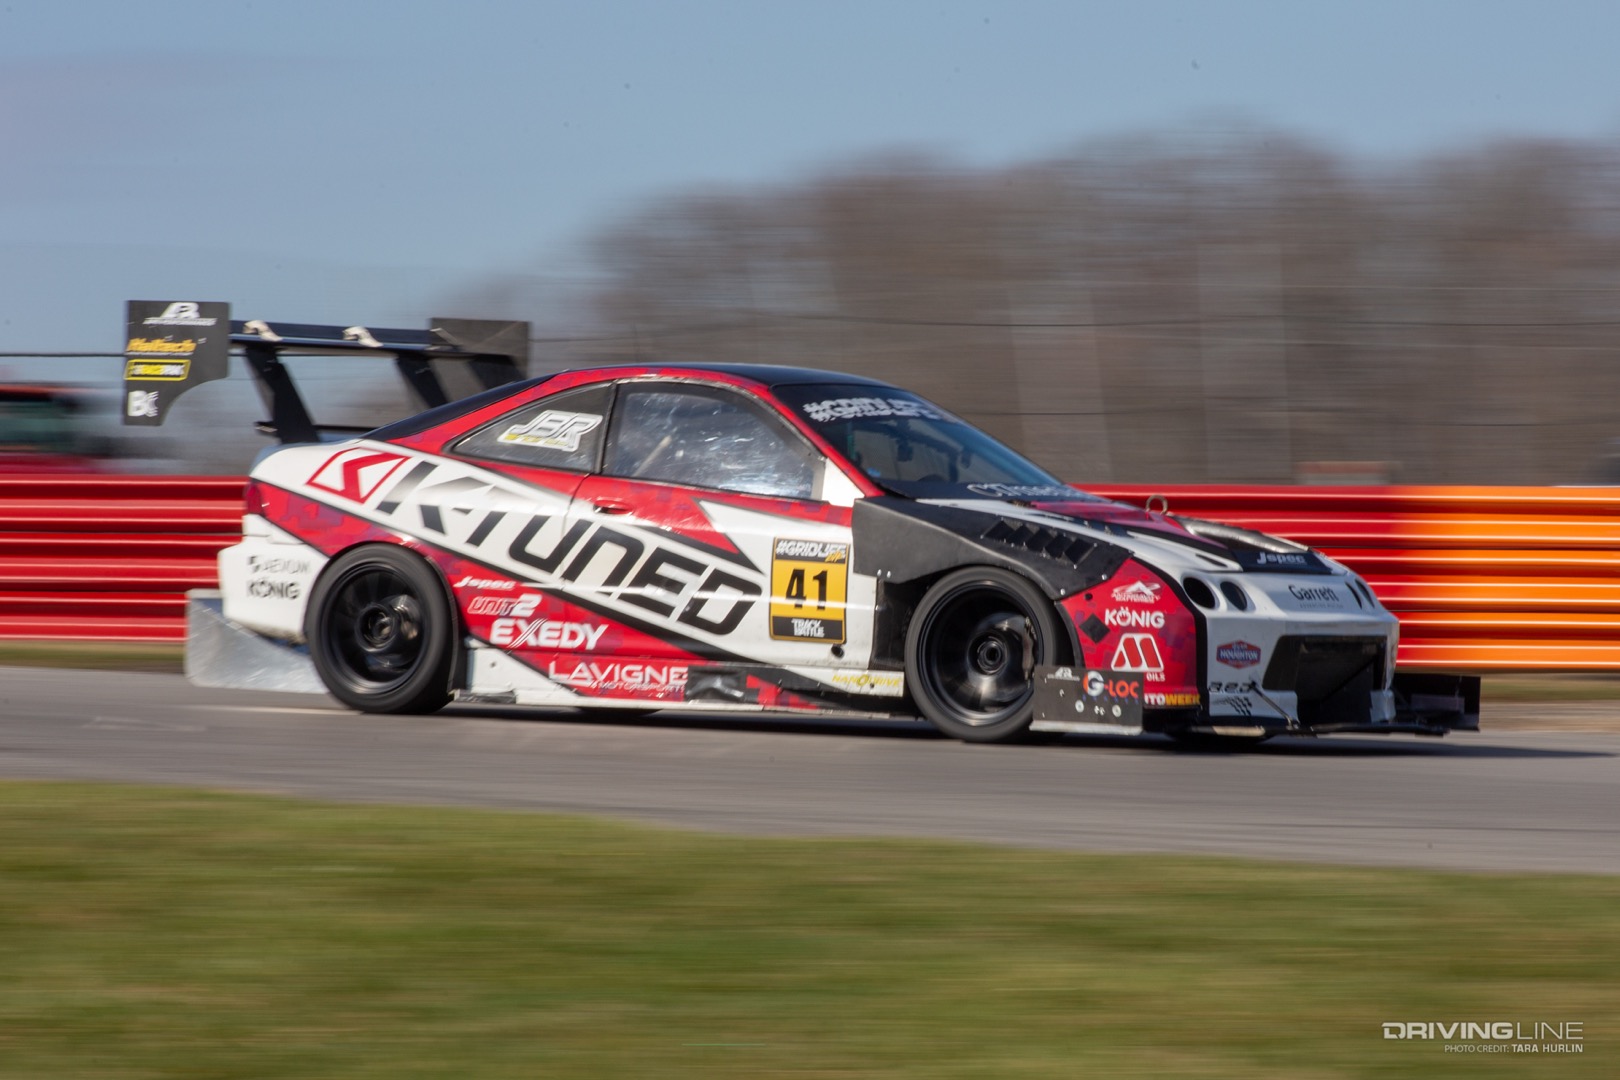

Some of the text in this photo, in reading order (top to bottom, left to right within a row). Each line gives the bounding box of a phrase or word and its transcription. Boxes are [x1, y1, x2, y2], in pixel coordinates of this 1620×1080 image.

[785, 568, 828, 611] 41
[1105, 606, 1165, 629] KÖNIG
[489, 618, 609, 650] EXEDY
[549, 661, 688, 687] LAVIGNE
